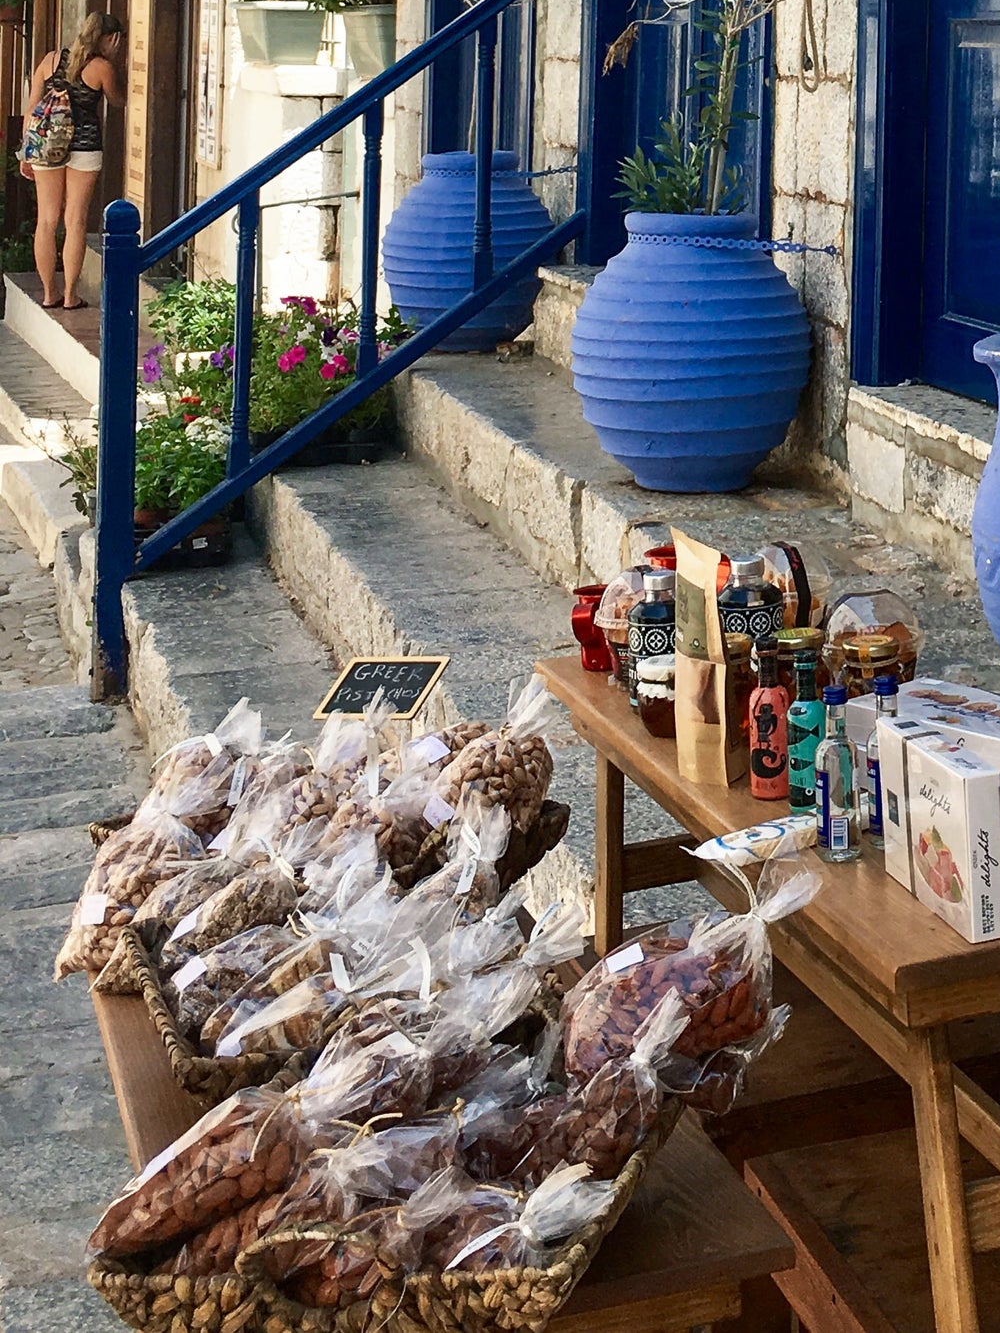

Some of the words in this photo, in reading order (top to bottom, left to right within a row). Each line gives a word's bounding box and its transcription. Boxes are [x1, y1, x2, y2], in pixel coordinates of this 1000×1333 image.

[354, 663, 423, 682] GREEK
[919, 783, 951, 817] delights
[979, 827, 999, 887] delights
